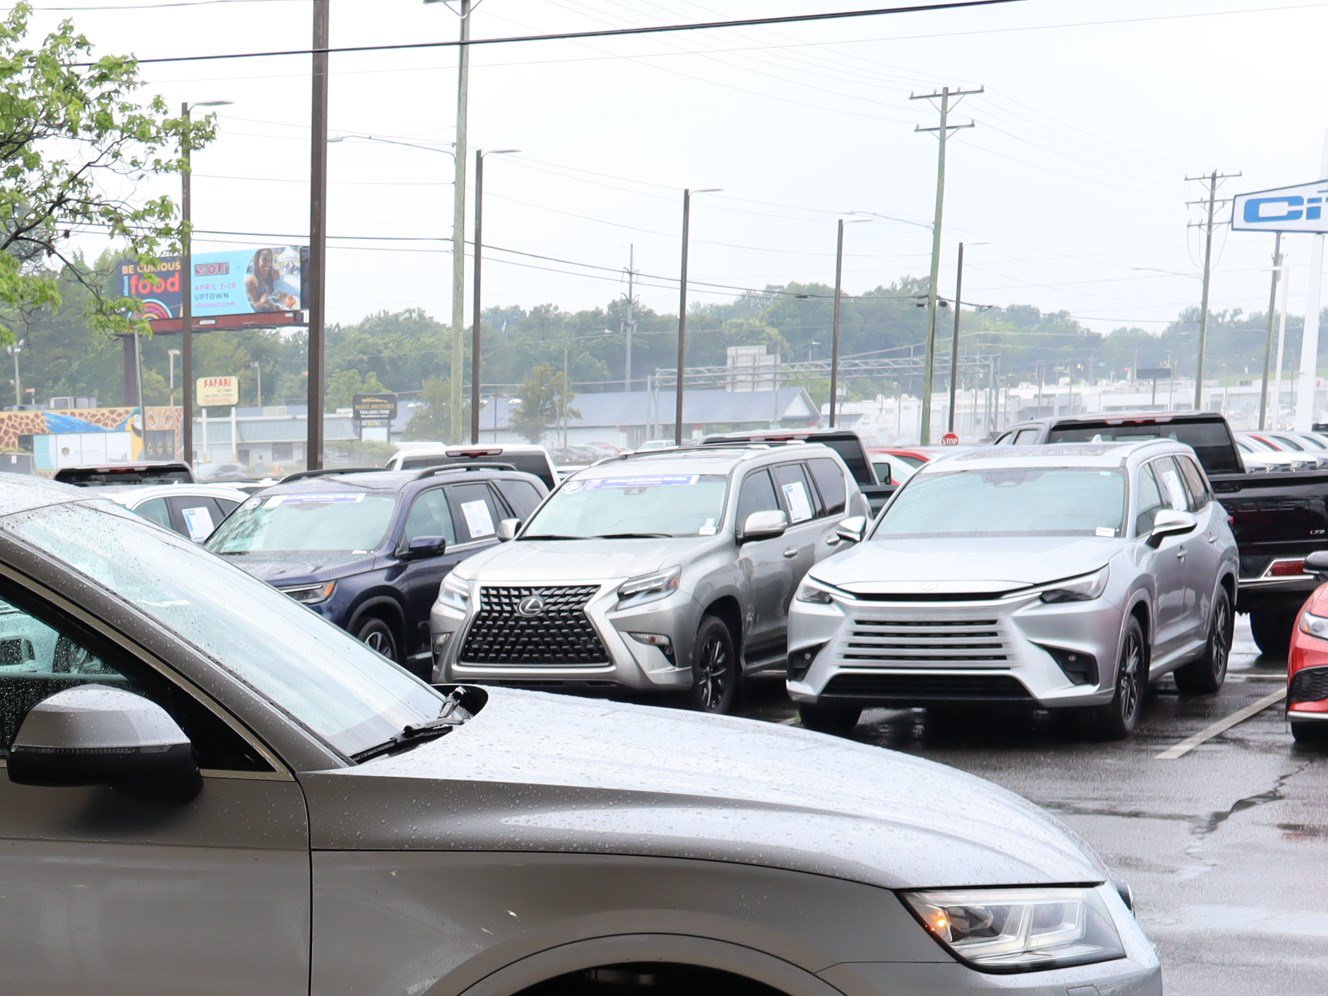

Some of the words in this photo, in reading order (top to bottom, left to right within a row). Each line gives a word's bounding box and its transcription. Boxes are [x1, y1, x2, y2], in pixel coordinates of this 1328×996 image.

[122, 264, 135, 275] BE
[137, 261, 181, 273] CURIOUS
[130, 272, 180, 296] food
[194, 283, 217, 291] APRIL
[194, 292, 229, 301] UPTOWN
[203, 377, 232, 388] SAFARI
[941, 437, 959, 446] STOP
